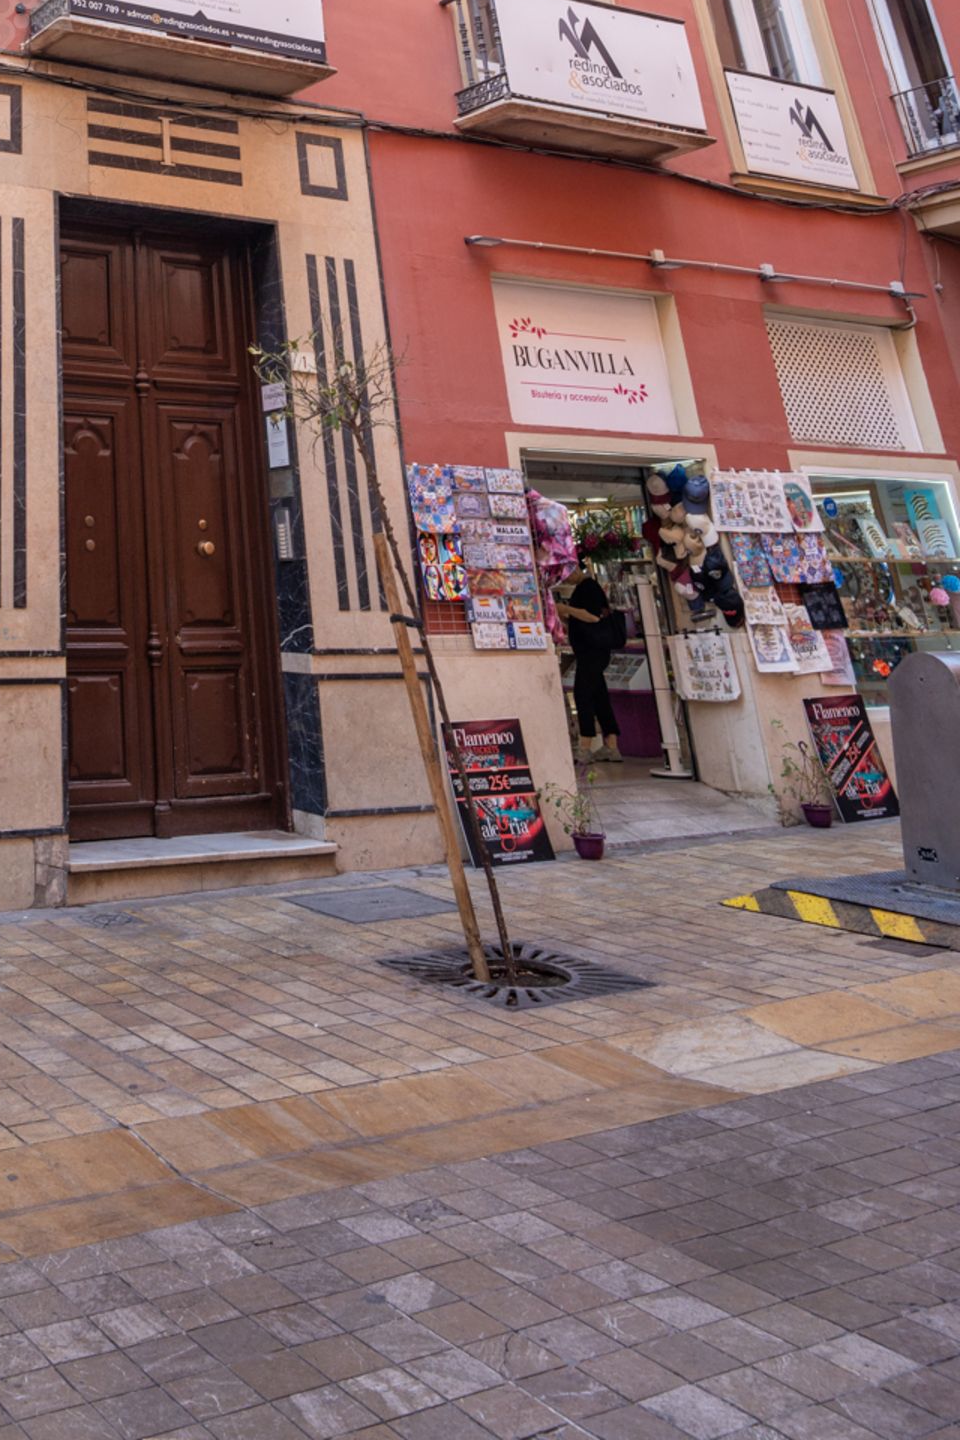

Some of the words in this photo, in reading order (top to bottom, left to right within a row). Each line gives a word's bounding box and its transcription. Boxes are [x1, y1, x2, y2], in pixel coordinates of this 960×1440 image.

[569, 59, 611, 79] reding
[798, 138, 828, 152] reding
[512, 344, 636, 376] BUGANVILLA
[569, 393, 609, 404] accesorios
[812, 703, 860, 720] Flamenco
[452, 728, 514, 747] Flamenco
[488, 774, 511, 791] 25€
